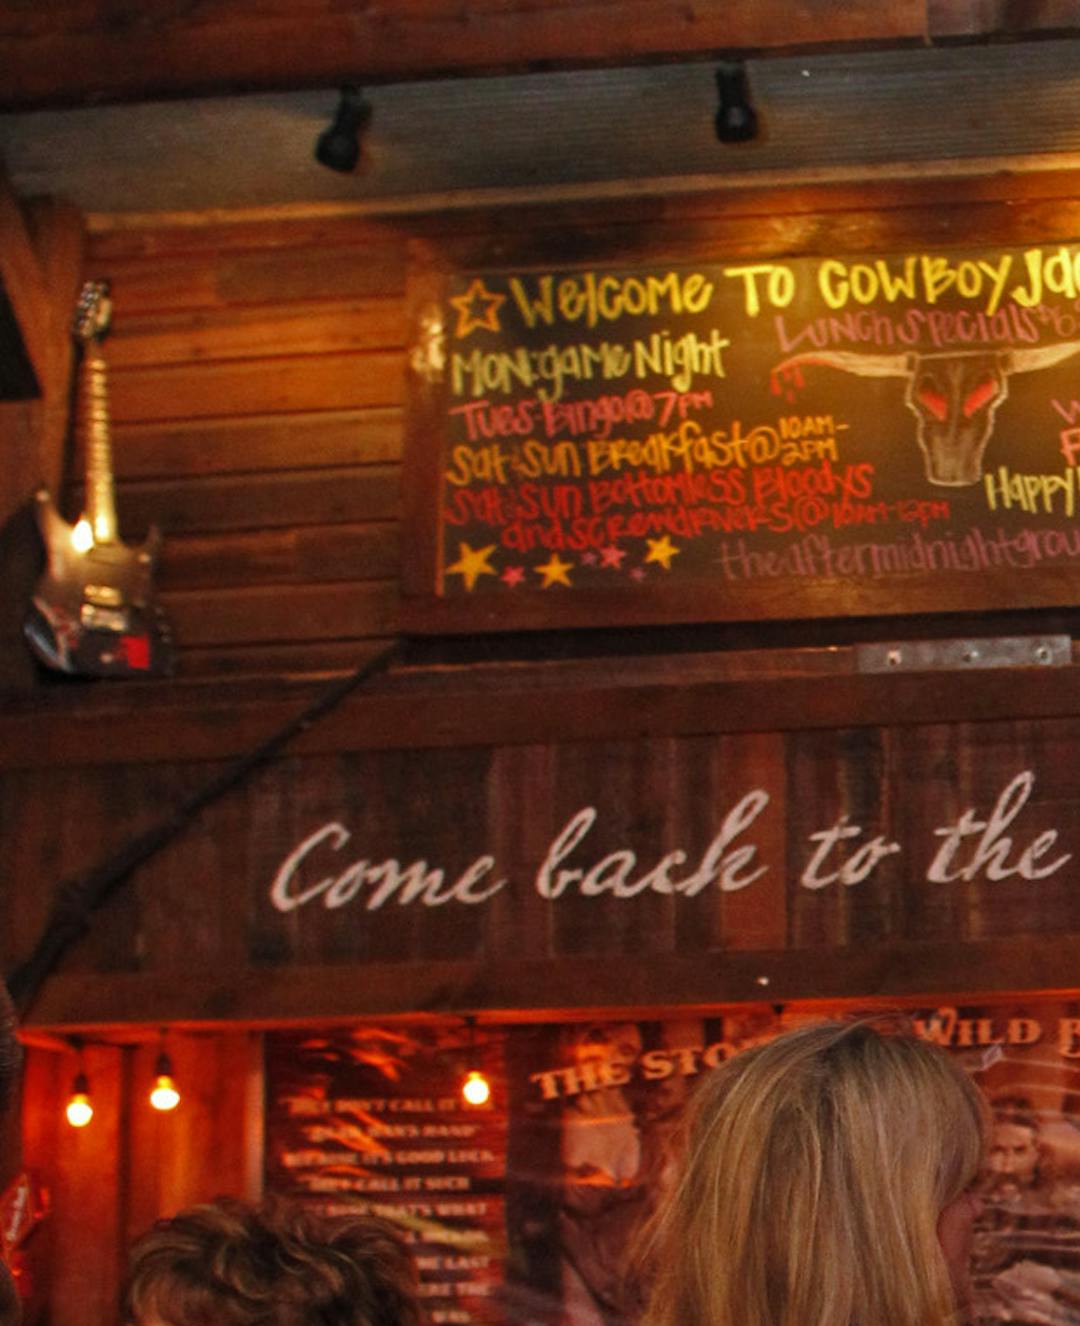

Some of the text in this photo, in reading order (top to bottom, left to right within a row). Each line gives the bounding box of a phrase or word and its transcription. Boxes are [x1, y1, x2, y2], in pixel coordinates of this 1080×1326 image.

[724, 264, 794, 316] TO
[634, 328, 730, 393] Night
[270, 822, 507, 912] Come
[536, 789, 770, 899] back
[799, 815, 900, 890] to
[926, 770, 1072, 883] the
[914, 1007, 1042, 1047] WILD
[530, 1040, 740, 1099] THE STO
